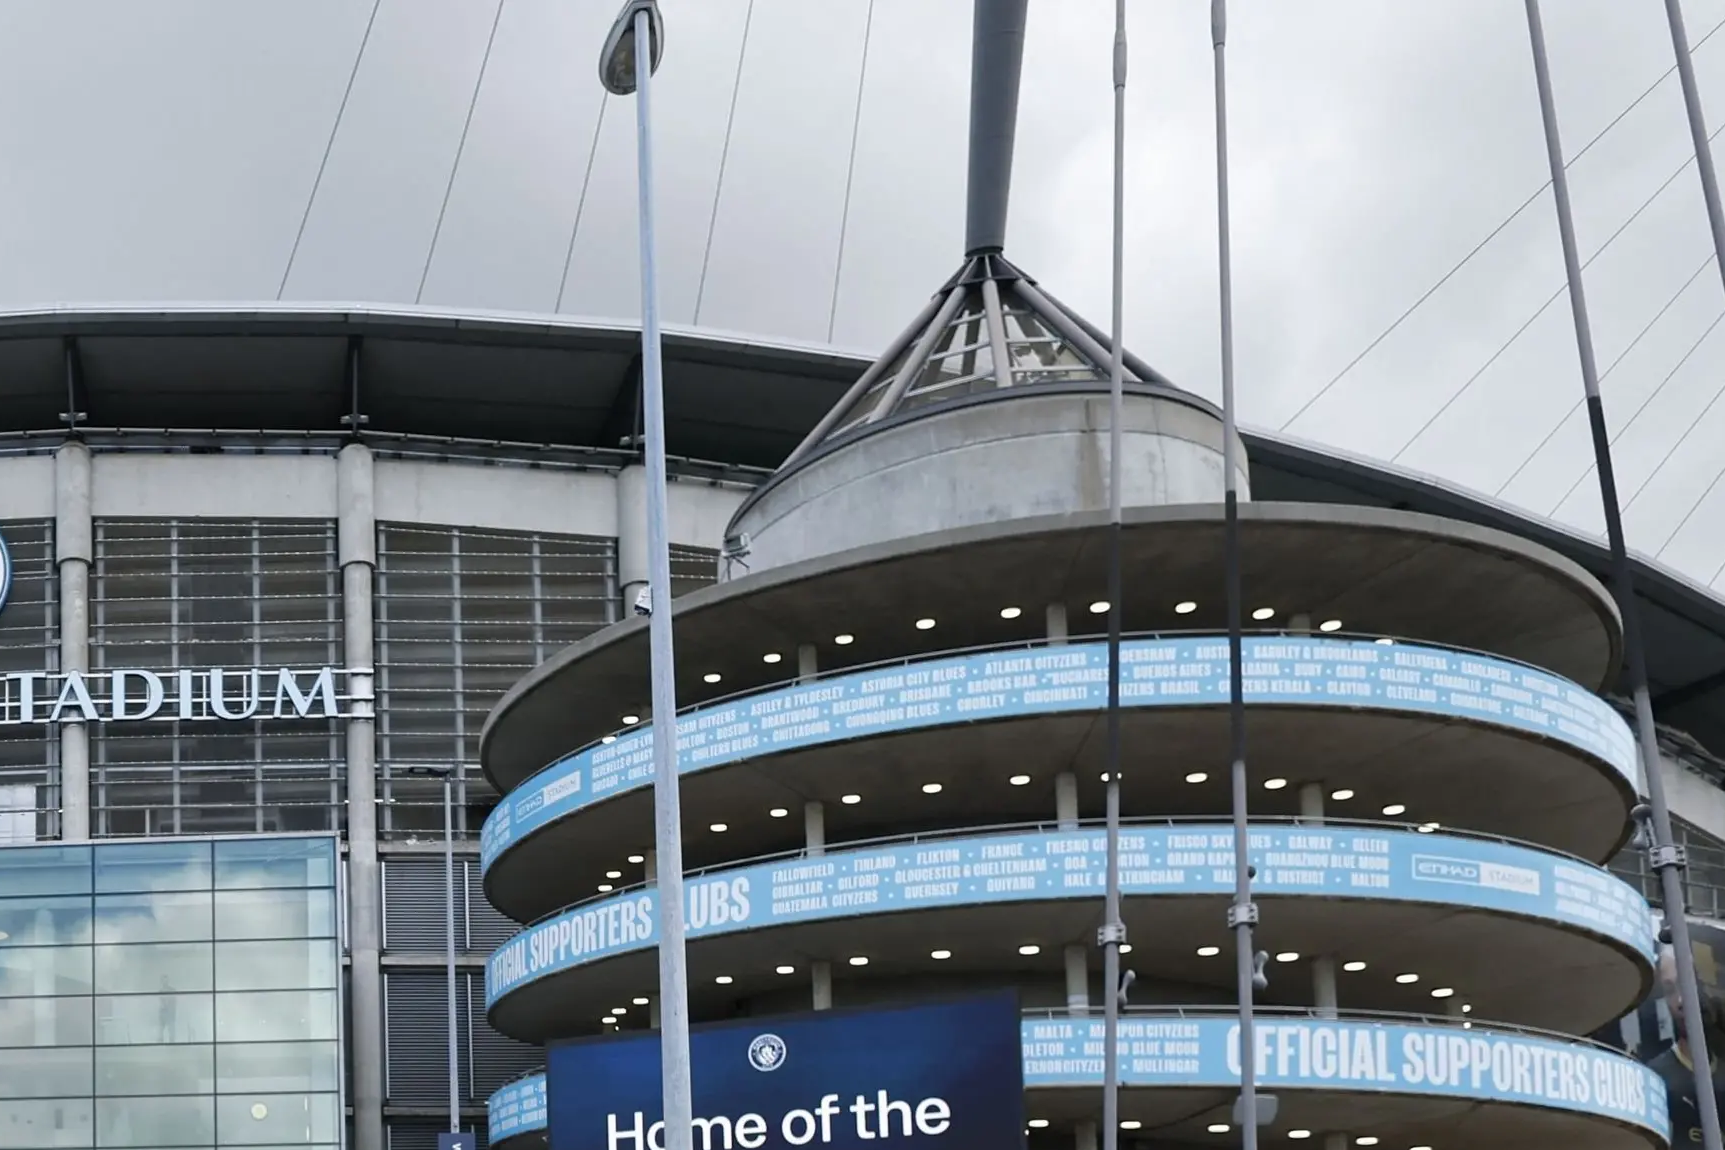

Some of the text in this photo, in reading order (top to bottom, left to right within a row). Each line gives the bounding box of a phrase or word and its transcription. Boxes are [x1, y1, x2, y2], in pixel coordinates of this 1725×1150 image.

[751, 652, 1087, 716] ASTLEY TYLDESLEY ASTORIA CITY BLUES ATLANTA CITYZENS
[967, 677, 1012, 694] BROOKS
[732, 694, 1006, 751] BLUES BLUES CHORLEY
[772, 839, 1089, 883] FALLOWFIELD FINLAND FRANCE FRESNO
[772, 852, 1205, 899] GIBRALTAR GLOUCESTER CHELTENHAM GRAND
[1418, 862, 1477, 878] ETIHAD
[772, 890, 878, 915] GUATEMALA CITYZENS
[530, 896, 653, 972] SUPPORTERS
[1034, 1024, 1199, 1039] MALTA CITYZENS
[1132, 1042, 1199, 1056] BLUE MOON
[1133, 1059, 1199, 1073] MULLINGAR
[1227, 1024, 1395, 1082] OFFICIAL
[1401, 1032, 1589, 1103] SUPPORTERS
[1593, 1056, 1645, 1117] CLUBS
[781, 1094, 839, 1145] of
[850, 1090, 951, 1140] the
